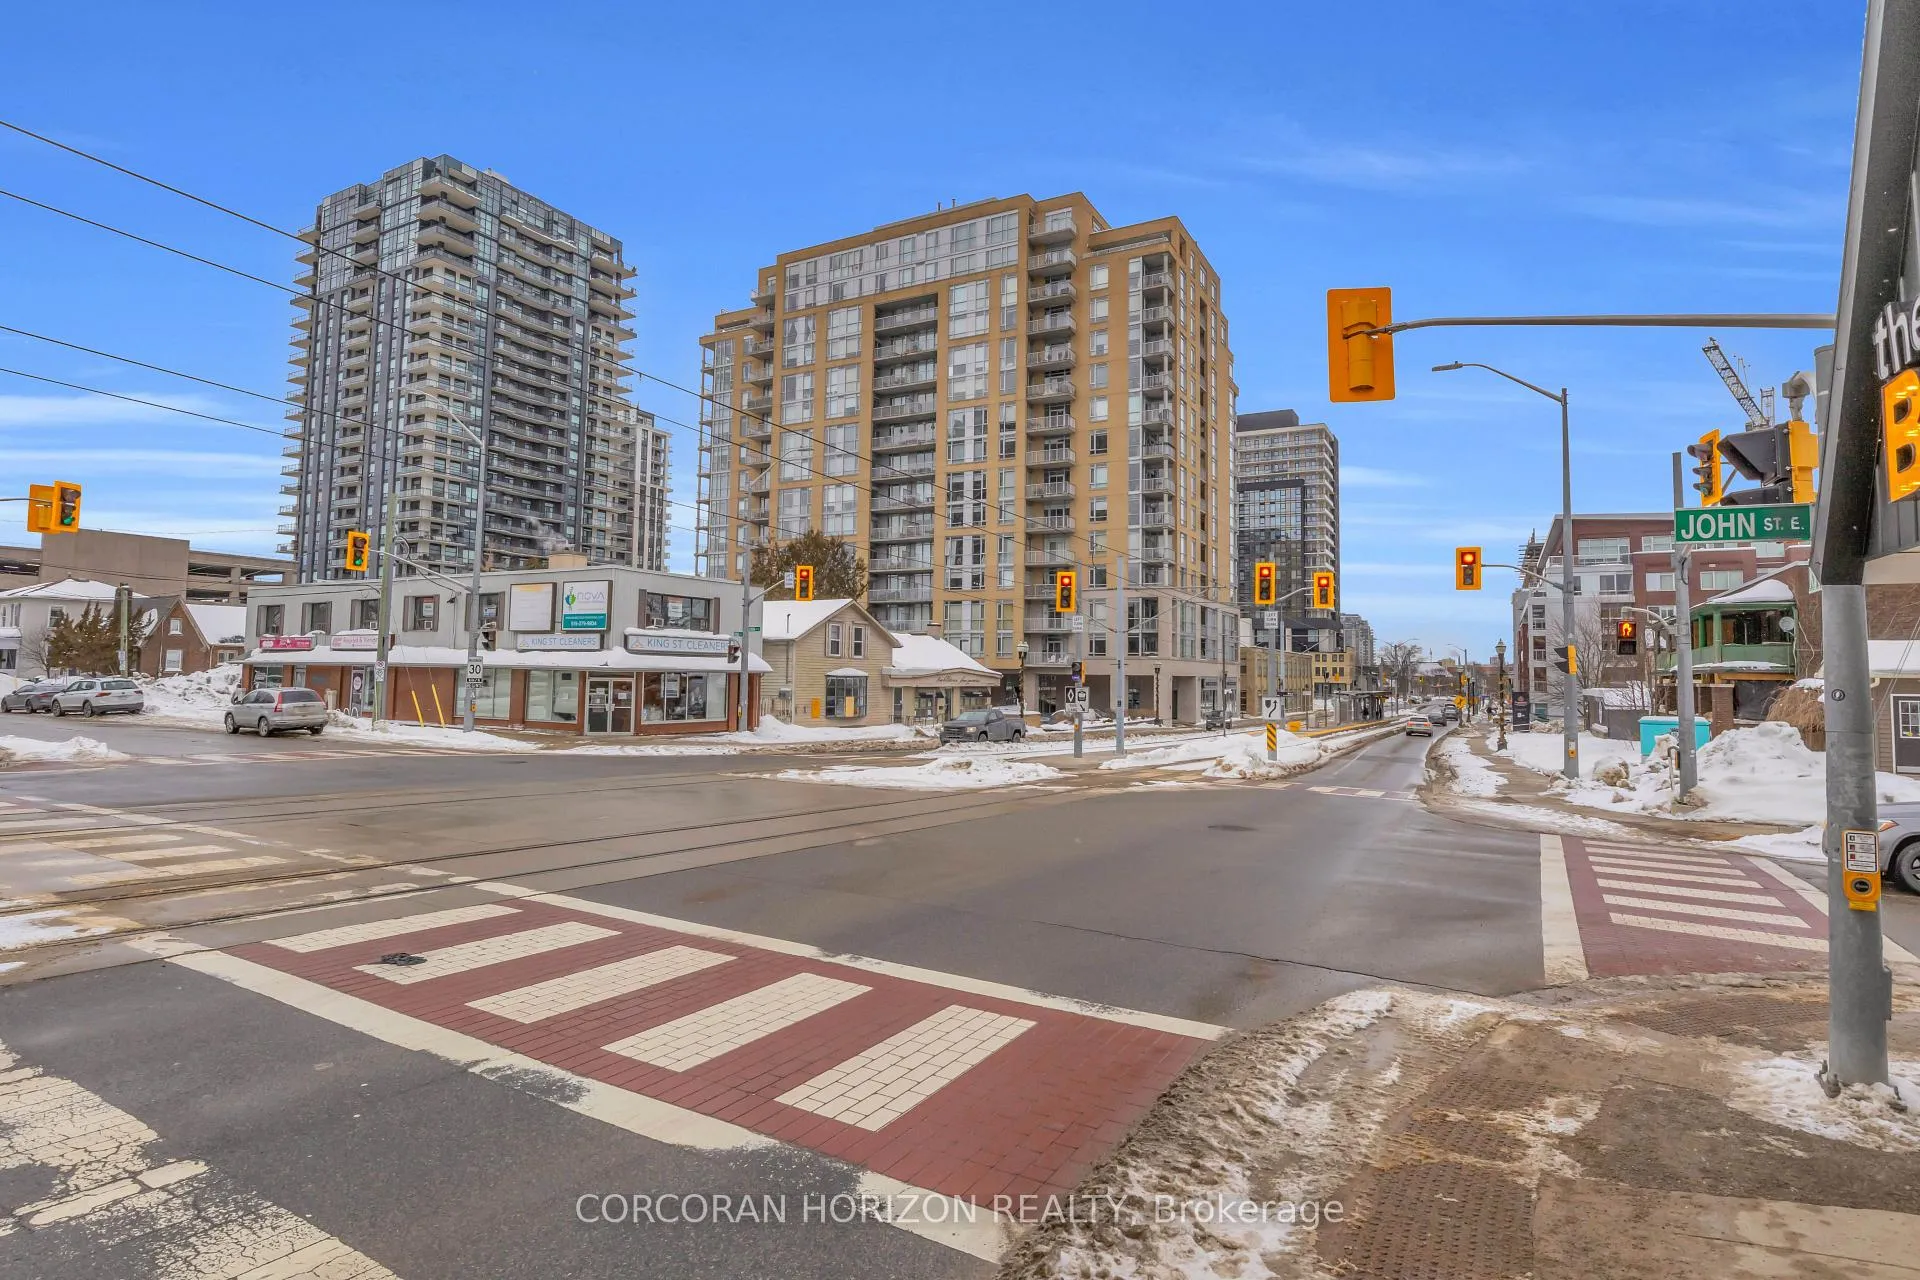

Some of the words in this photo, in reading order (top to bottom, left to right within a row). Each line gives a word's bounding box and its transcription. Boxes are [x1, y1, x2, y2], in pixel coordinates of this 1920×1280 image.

[1680, 513, 1756, 540] JOHN
[1763, 517, 1784, 531] ST.
[1790, 516, 1805, 530] E.
[531, 637, 547, 646] KING
[548, 637, 557, 646] ST
[559, 637, 597, 647] CLEANERS
[647, 640, 670, 649] KING
[672, 641, 683, 649] ST
[469, 664, 482, 675] 30
